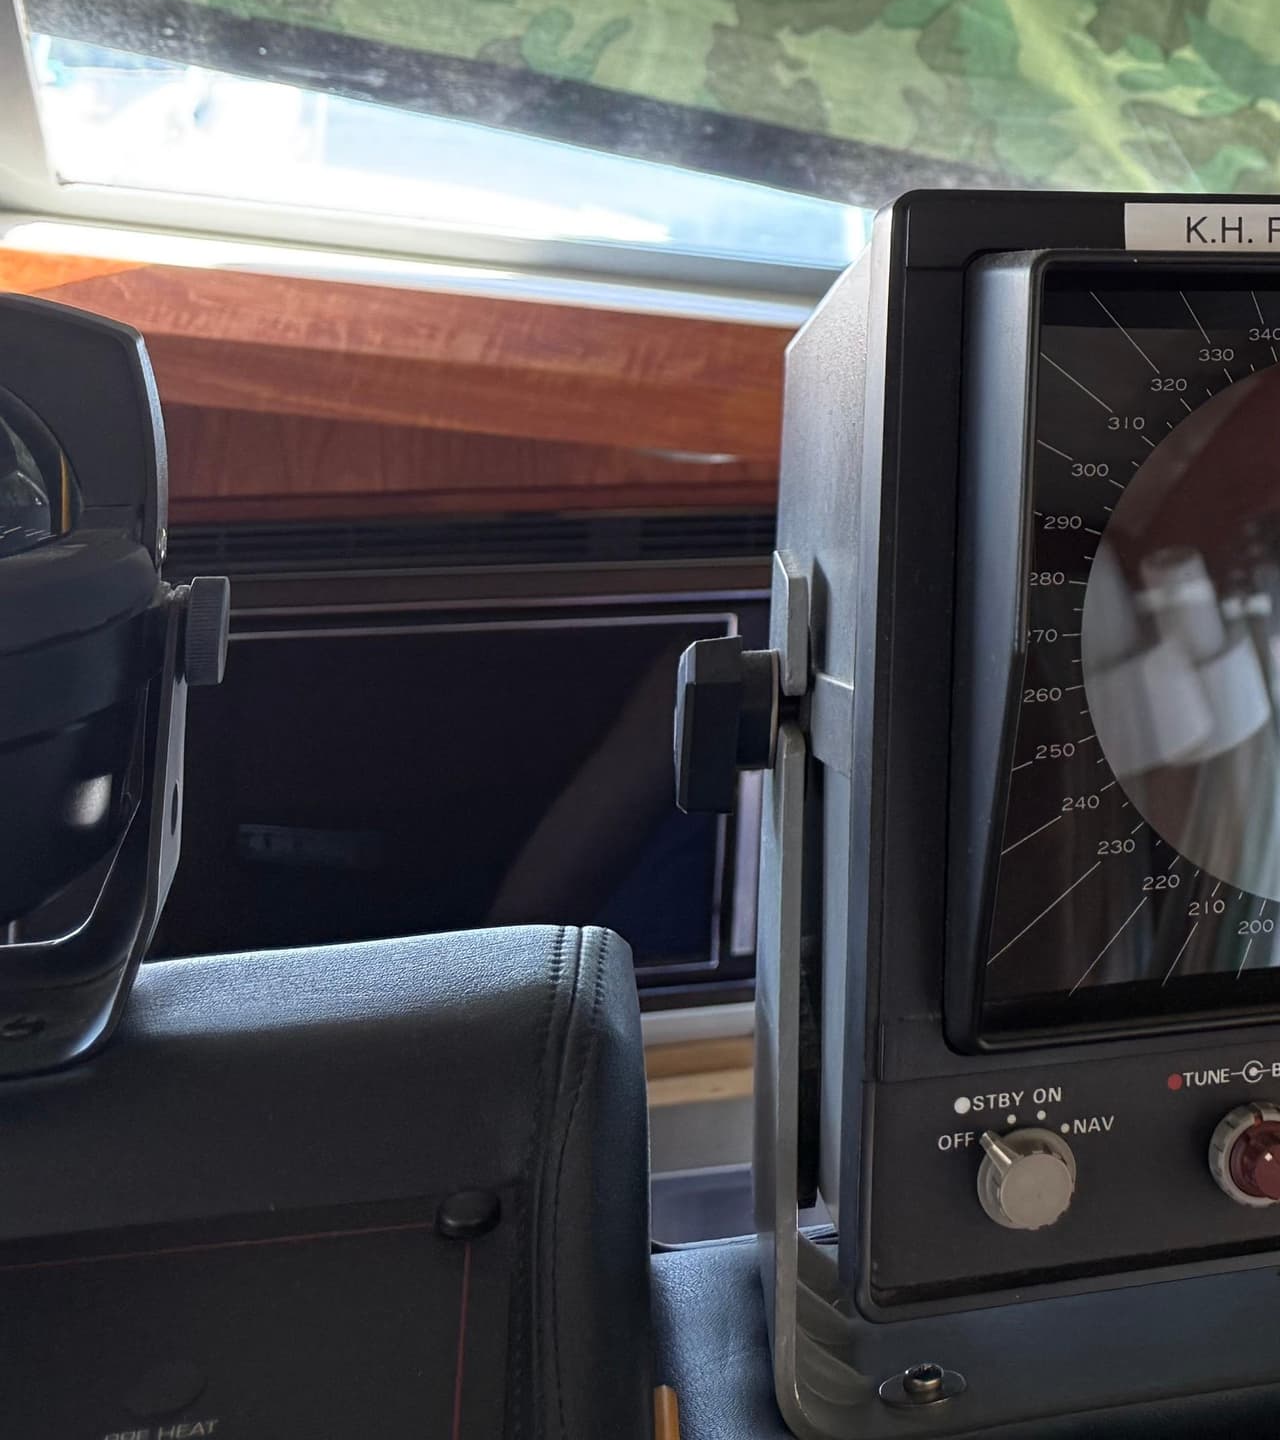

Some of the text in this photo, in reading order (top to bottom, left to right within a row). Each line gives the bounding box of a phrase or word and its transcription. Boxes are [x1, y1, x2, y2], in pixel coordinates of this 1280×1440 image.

[1185, 216, 1254, 244] K.H.
[1199, 348, 1235, 362] 330
[1150, 378, 1188, 392] 320
[1107, 416, 1146, 431] 310
[1071, 463, 1110, 478] 300
[1043, 515, 1083, 530] 290
[1023, 687, 1063, 704] 260
[1035, 742, 1076, 760] 250
[1062, 794, 1101, 812] 240
[1097, 838, 1137, 856] 230
[1142, 874, 1181, 891] 220
[1188, 899, 1226, 916] 210
[1238, 919, 1275, 935] 200
[1182, 1068, 1231, 1088] TUNE
[972, 1086, 1063, 1111] STBY ON
[1073, 1115, 1115, 1135] NAV
[937, 1131, 975, 1151] OFF
